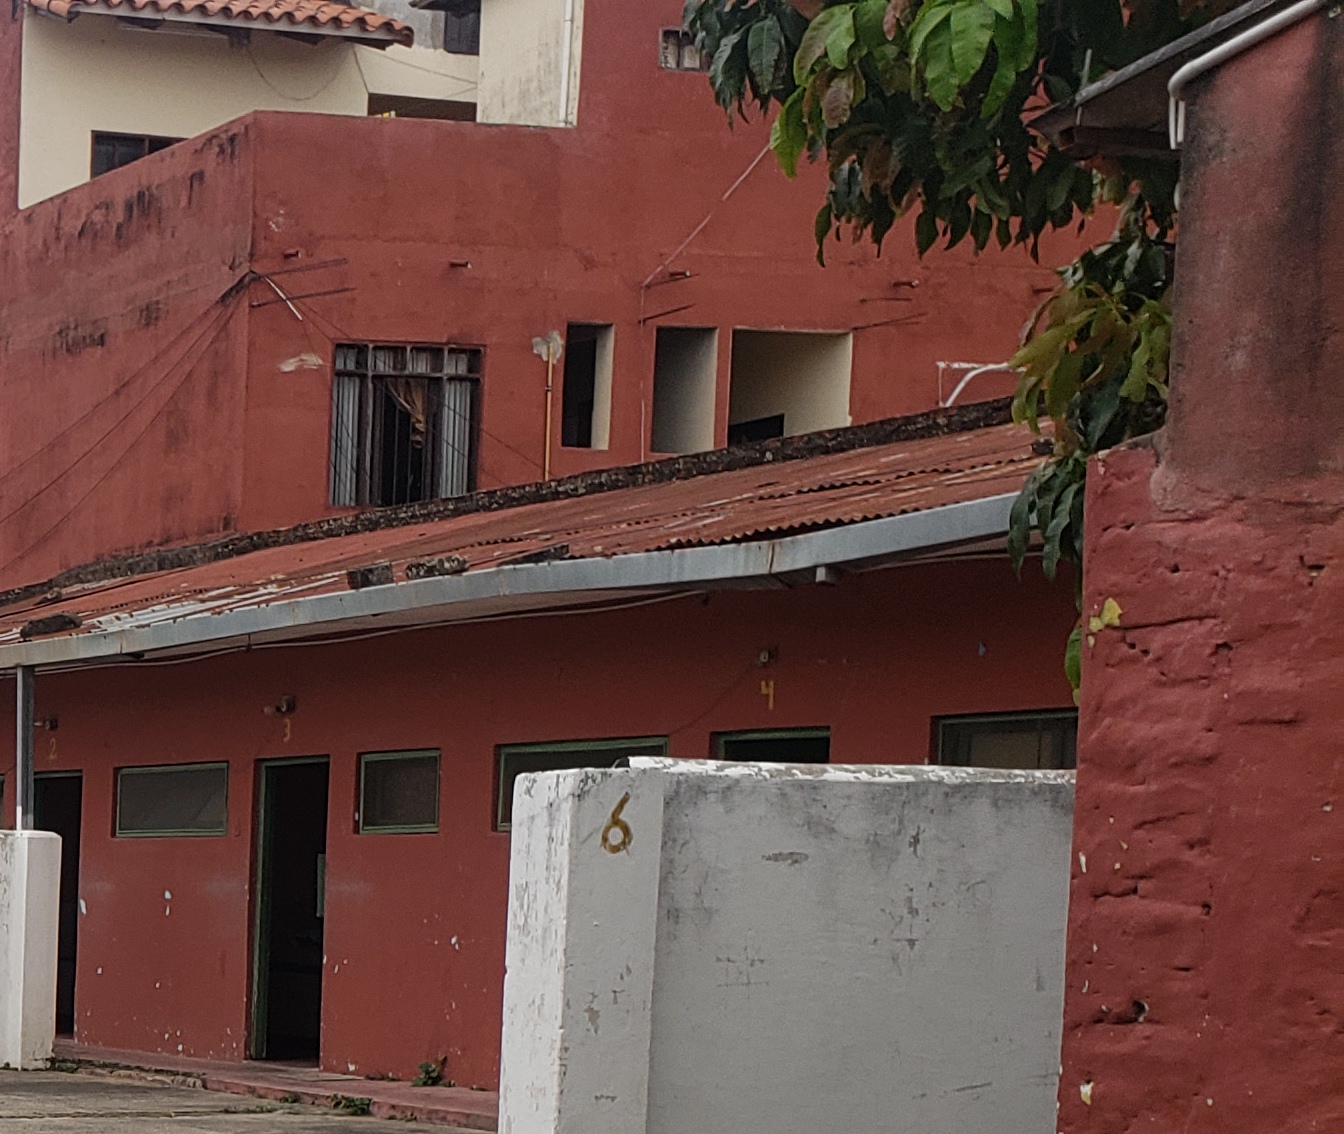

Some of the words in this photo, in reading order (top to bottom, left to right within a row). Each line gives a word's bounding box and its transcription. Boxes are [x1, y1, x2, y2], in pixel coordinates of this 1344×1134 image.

[760, 680, 775, 711] 4
[283, 718, 291, 742] 3
[49, 737, 57, 760] 2
[601, 791, 633, 854] 6
